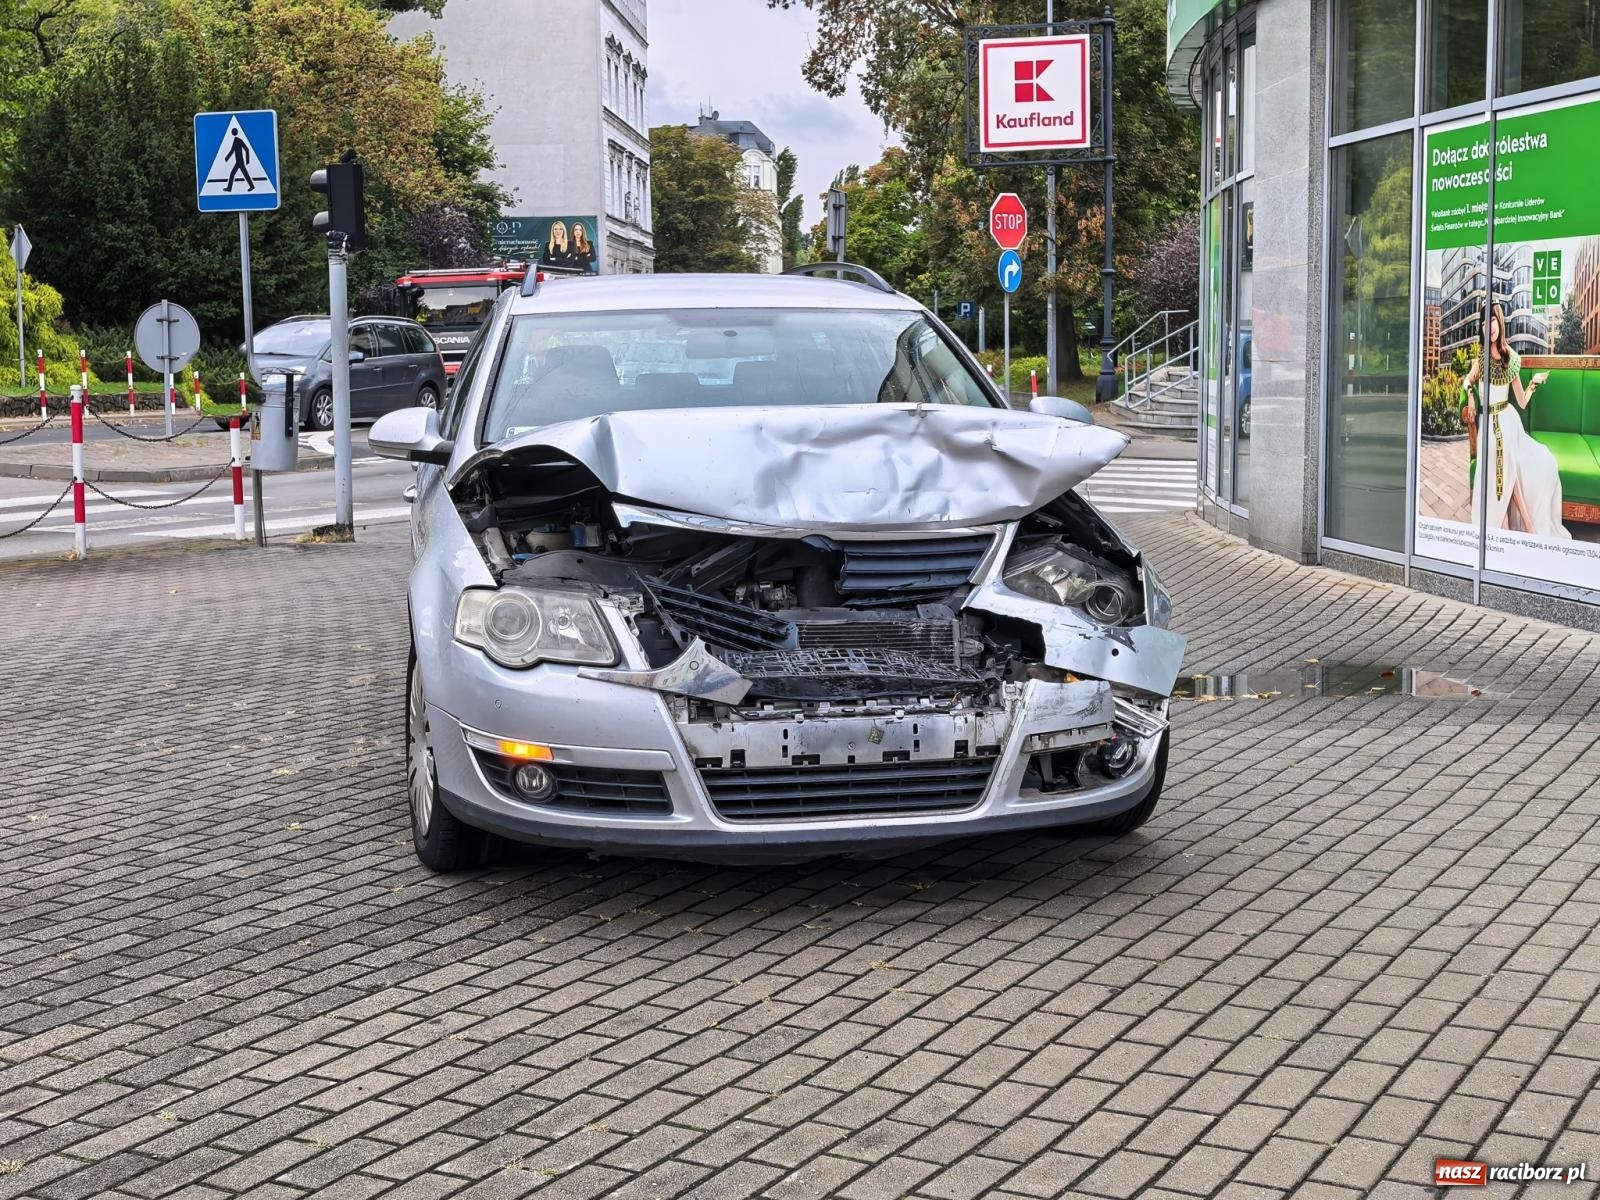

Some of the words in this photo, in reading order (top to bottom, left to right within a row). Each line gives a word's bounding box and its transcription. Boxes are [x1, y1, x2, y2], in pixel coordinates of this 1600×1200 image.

[996, 110, 1074, 129] Kaufland
[1432, 146, 1468, 167] Dołącz
[1499, 199, 1524, 209] Konkursie
[1524, 197, 1545, 207] Liderów
[995, 214, 1023, 230] STOP
[433, 336, 470, 344] SCANIA
